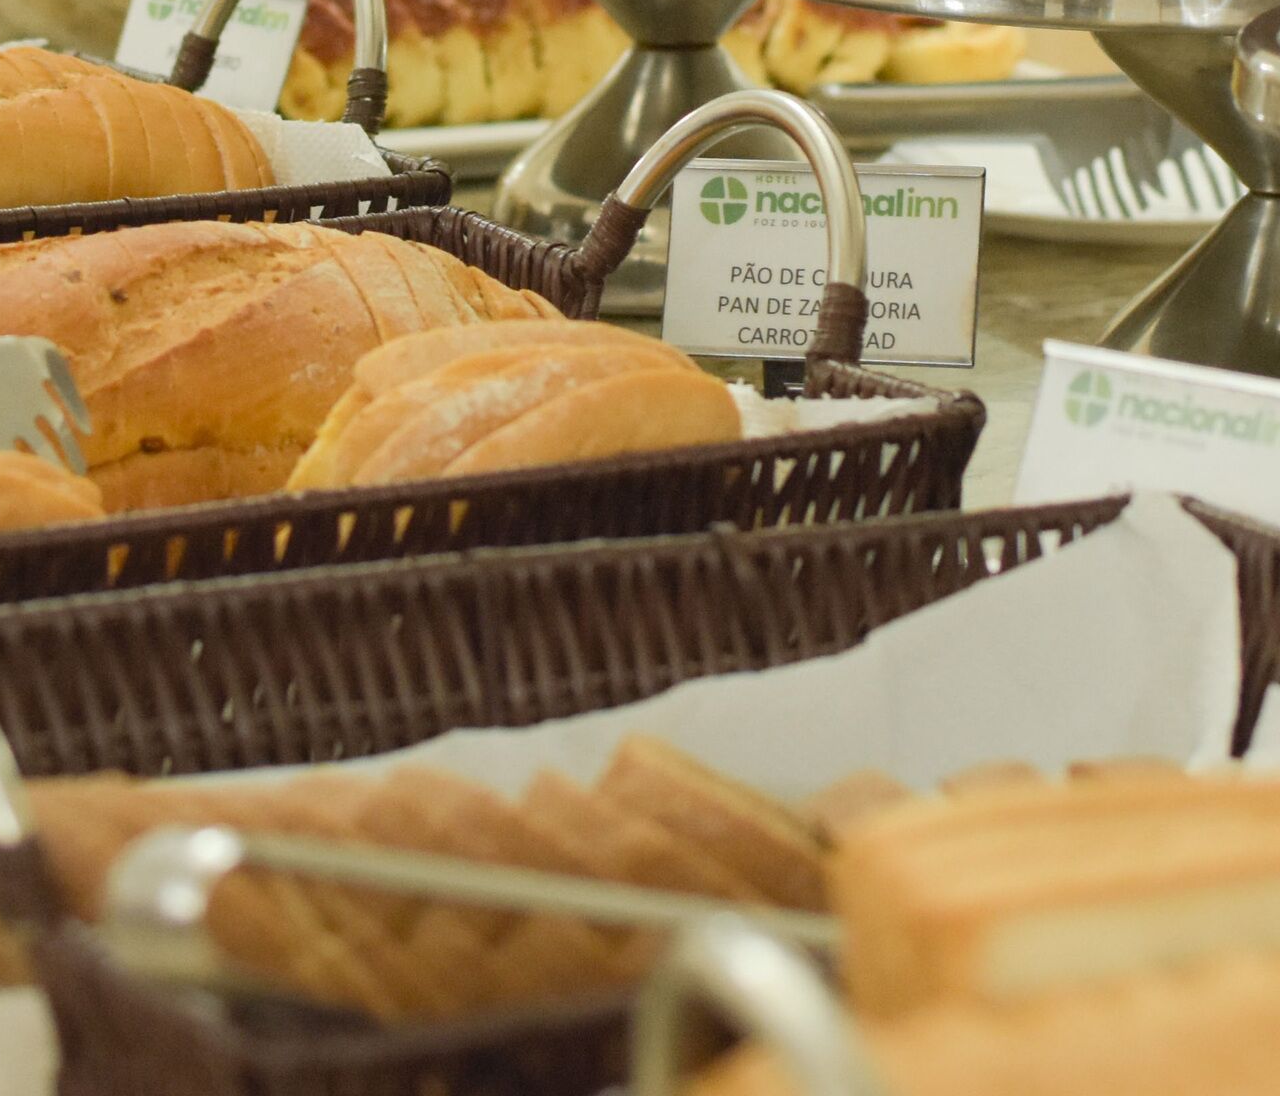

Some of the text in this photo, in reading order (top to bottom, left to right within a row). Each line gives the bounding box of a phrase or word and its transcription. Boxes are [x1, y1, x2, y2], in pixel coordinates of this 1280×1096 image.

[755, 174, 798, 185] HOTEL
[753, 217, 776, 228] FOZ
[781, 219, 799, 229] DO
[729, 263, 914, 290] PÃO DE CURA
[717, 295, 922, 321] PAN DE ZAORIA
